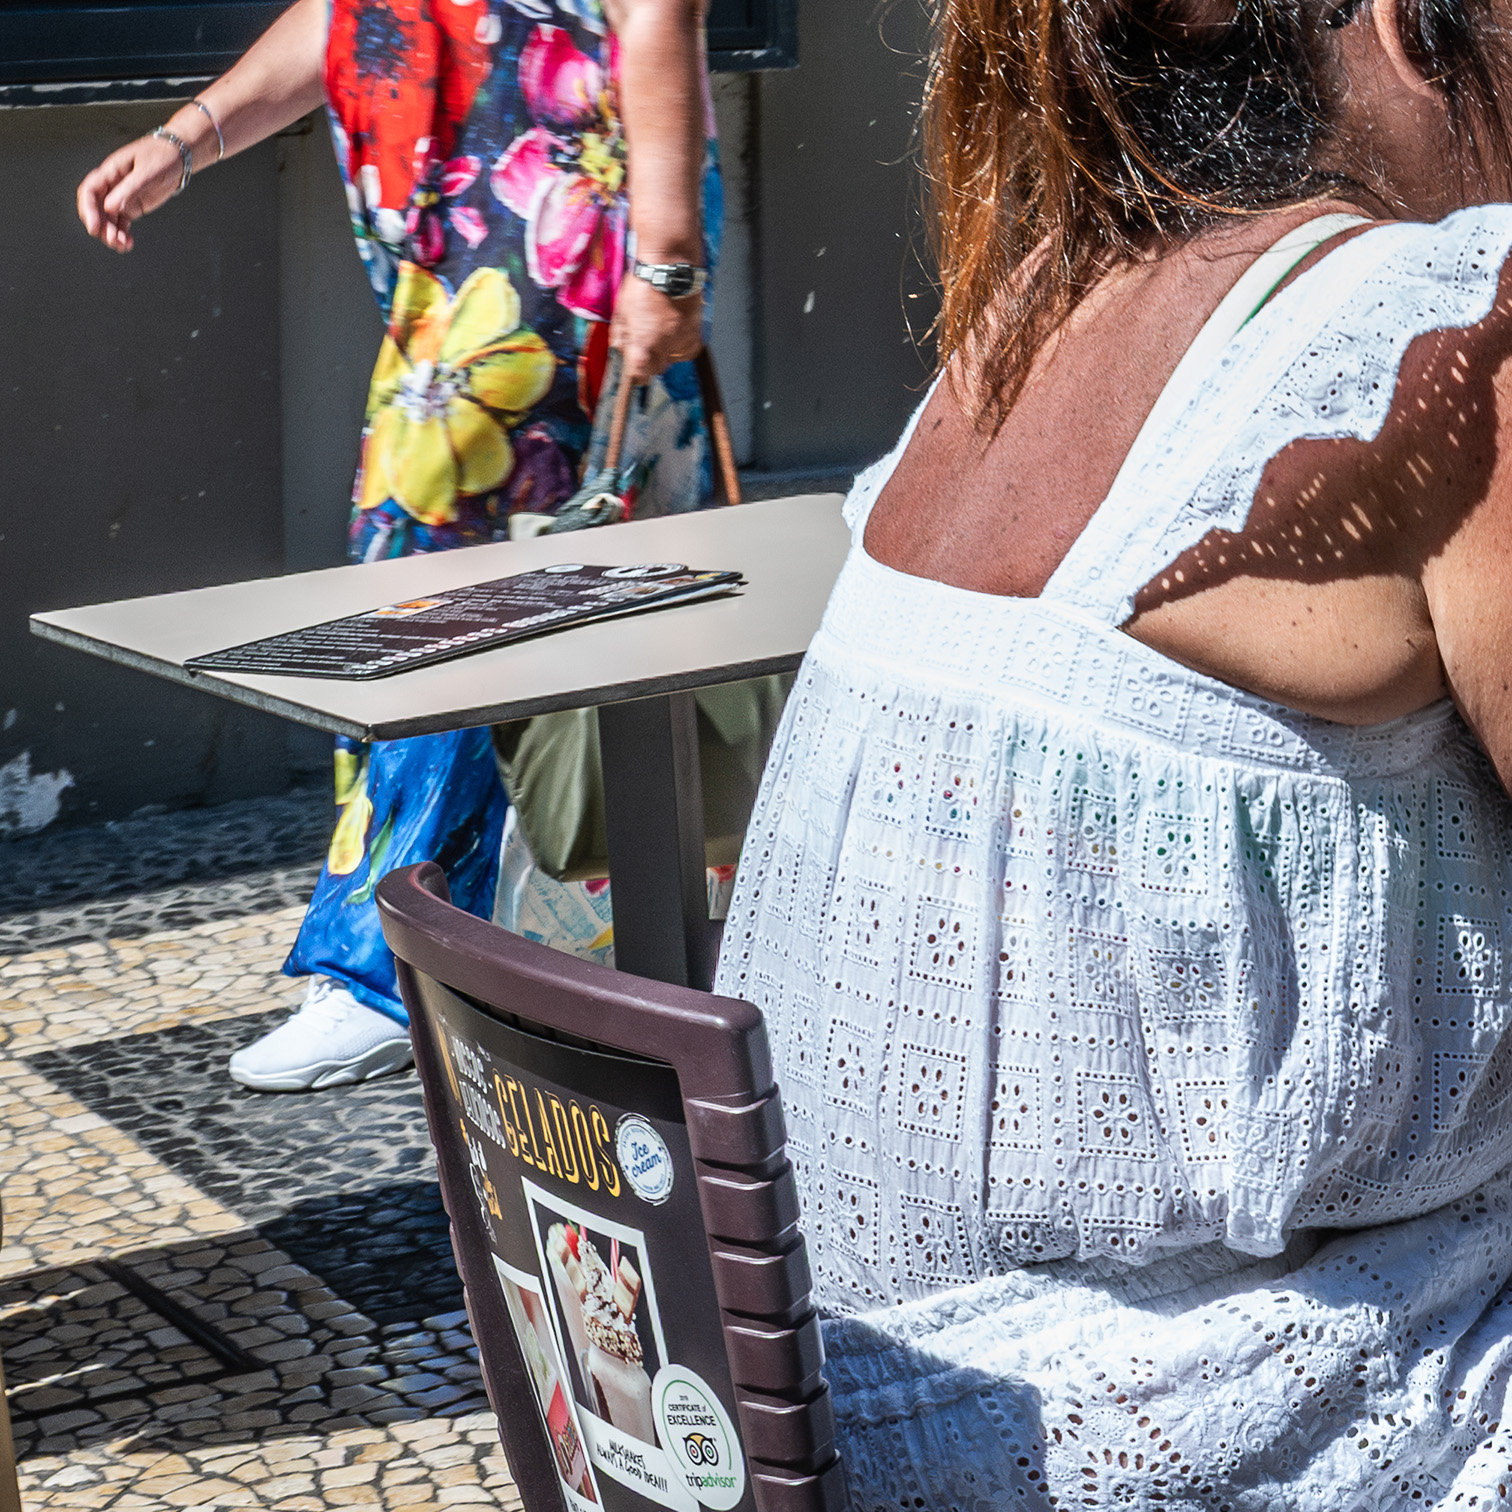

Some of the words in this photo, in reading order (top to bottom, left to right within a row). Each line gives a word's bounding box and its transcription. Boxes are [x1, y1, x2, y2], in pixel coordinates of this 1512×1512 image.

[492, 1068, 621, 1197] GELADOS
[631, 1141, 650, 1162] Ice
[632, 1151, 662, 1178] cream
[668, 1403, 701, 1413] CERTIFICATE
[667, 1414, 717, 1427] EXCELLENCE
[685, 1471, 737, 1491] tripadvisor
